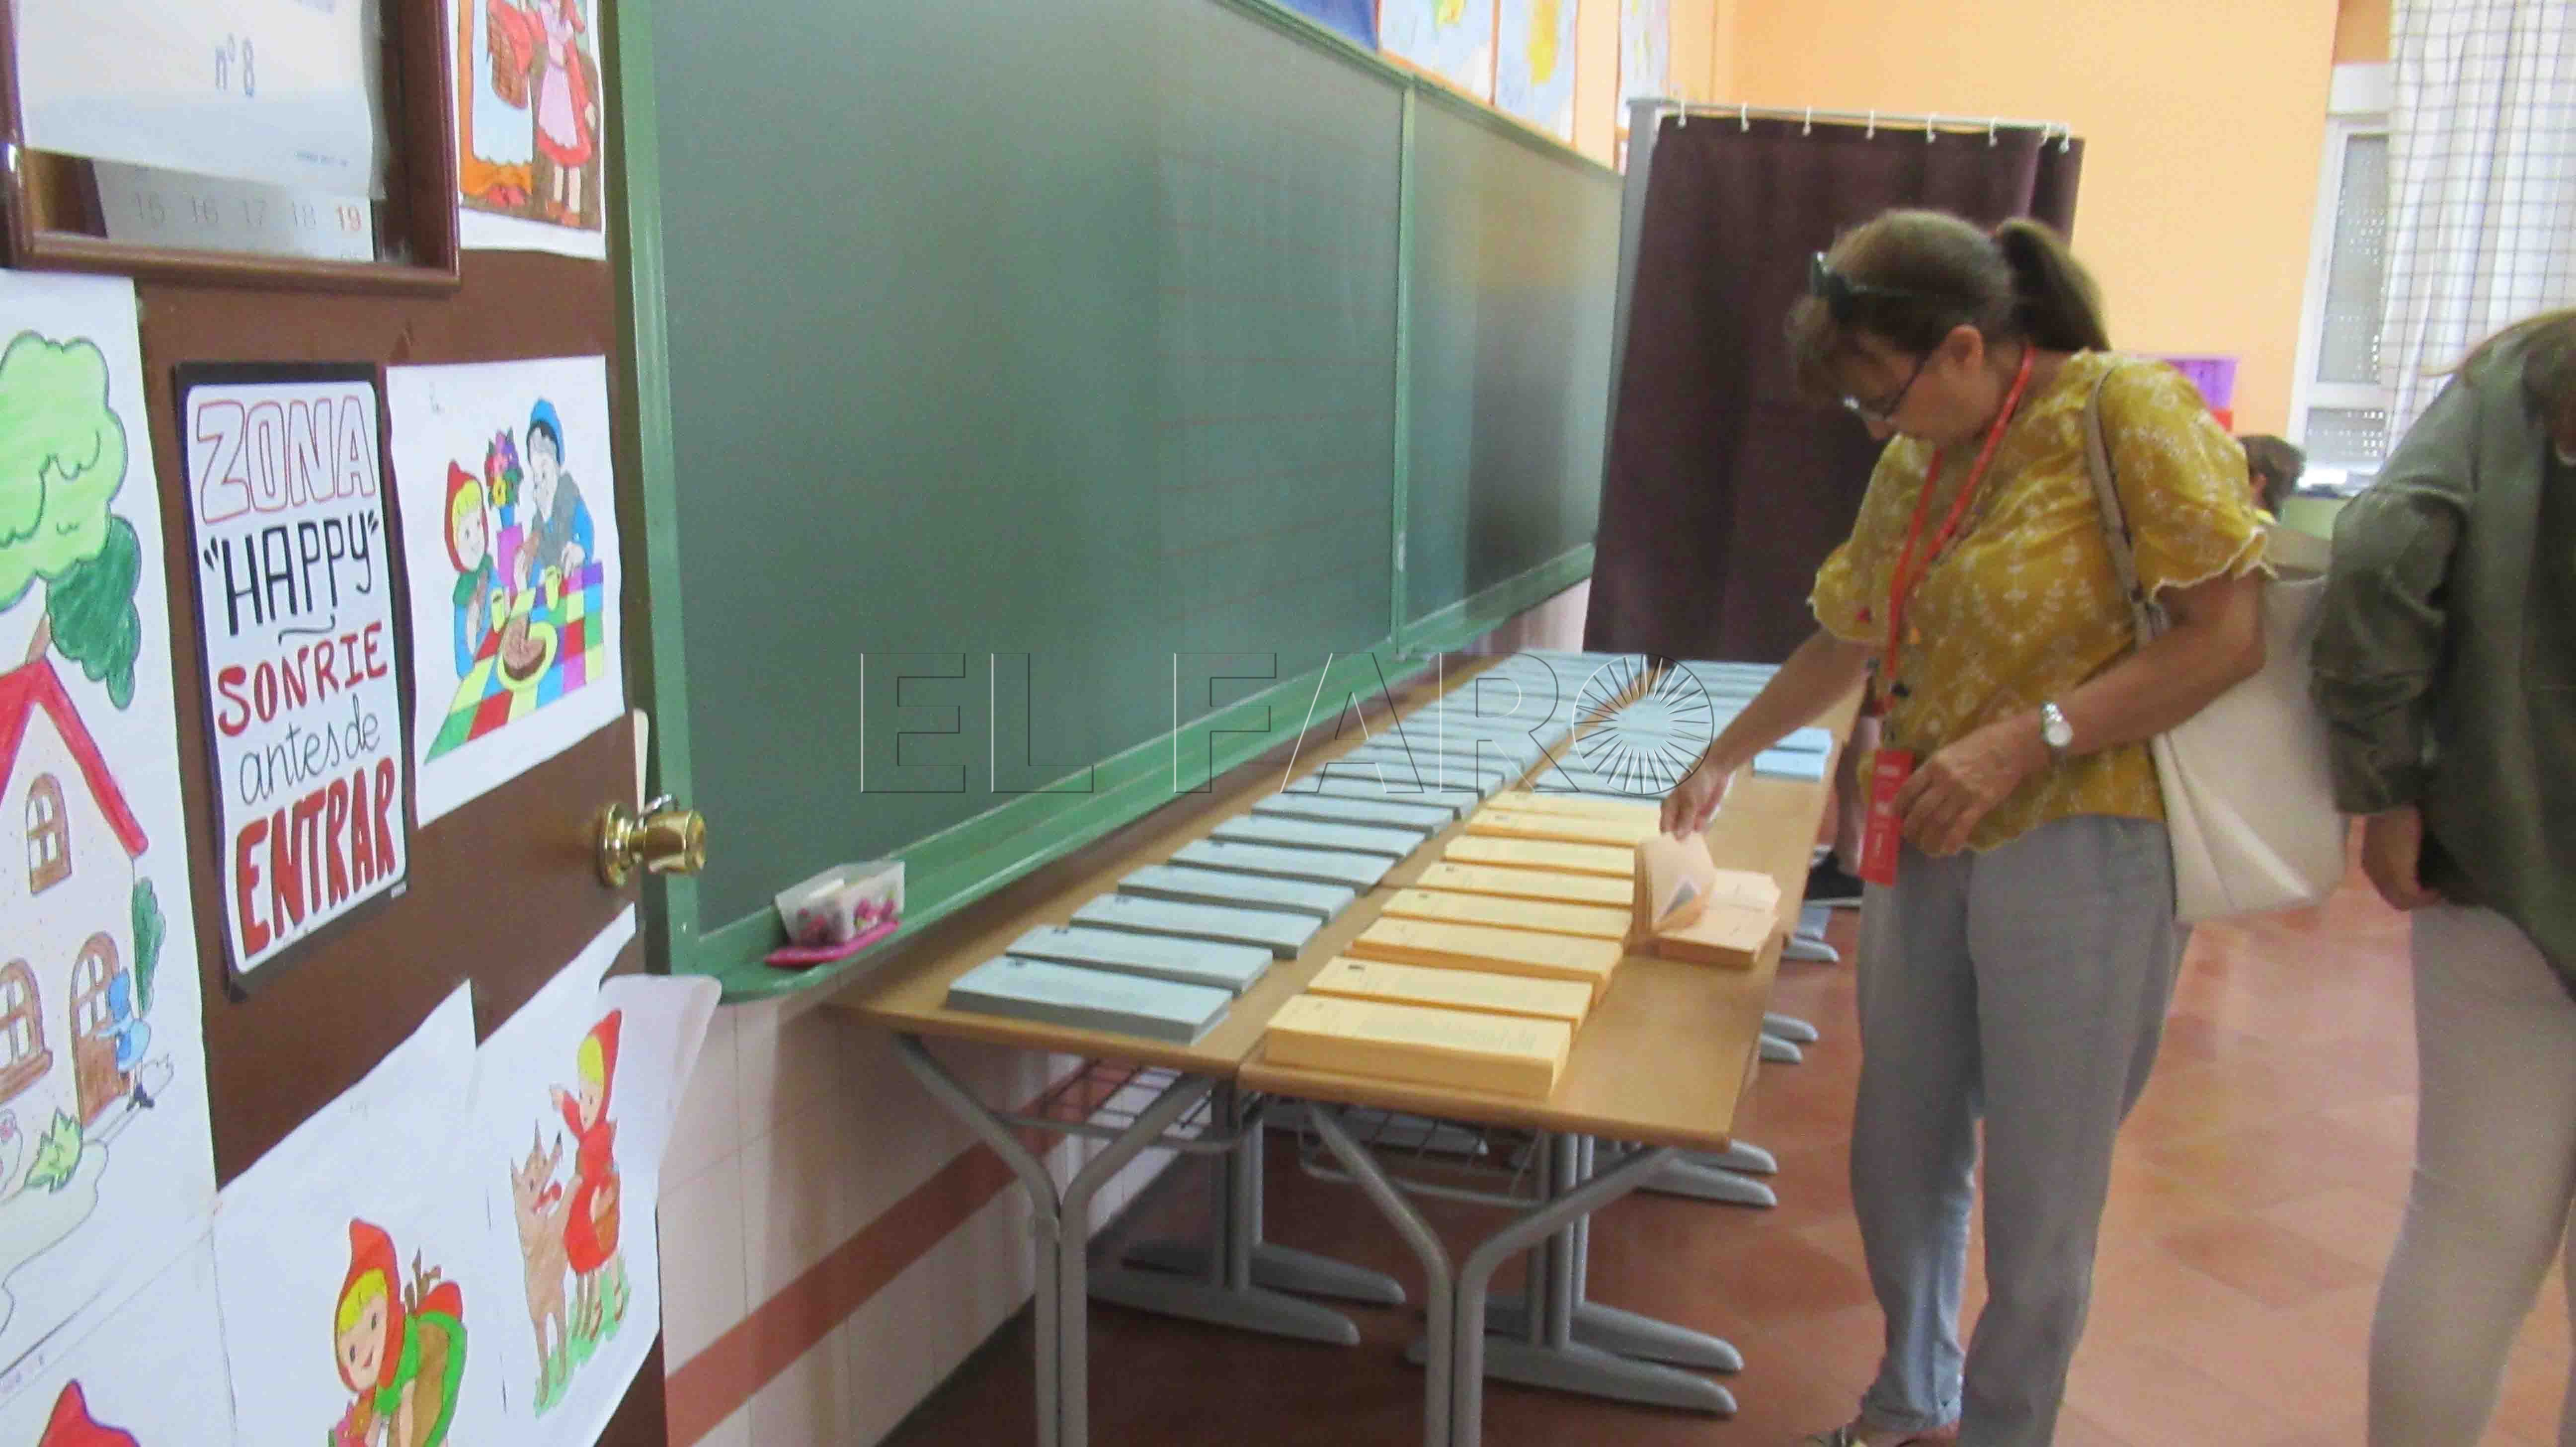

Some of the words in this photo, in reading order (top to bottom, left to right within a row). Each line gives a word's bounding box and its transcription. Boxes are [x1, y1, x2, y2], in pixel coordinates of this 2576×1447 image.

[243, 198, 267, 228] 17
[292, 200, 317, 230] 18
[336, 203, 362, 232] 19
[197, 396, 376, 525] ZONA
[218, 620, 389, 737] SONRIE
[240, 721, 340, 806] antes
[345, 692, 381, 759] de
[236, 756, 396, 959] ENTRAR
